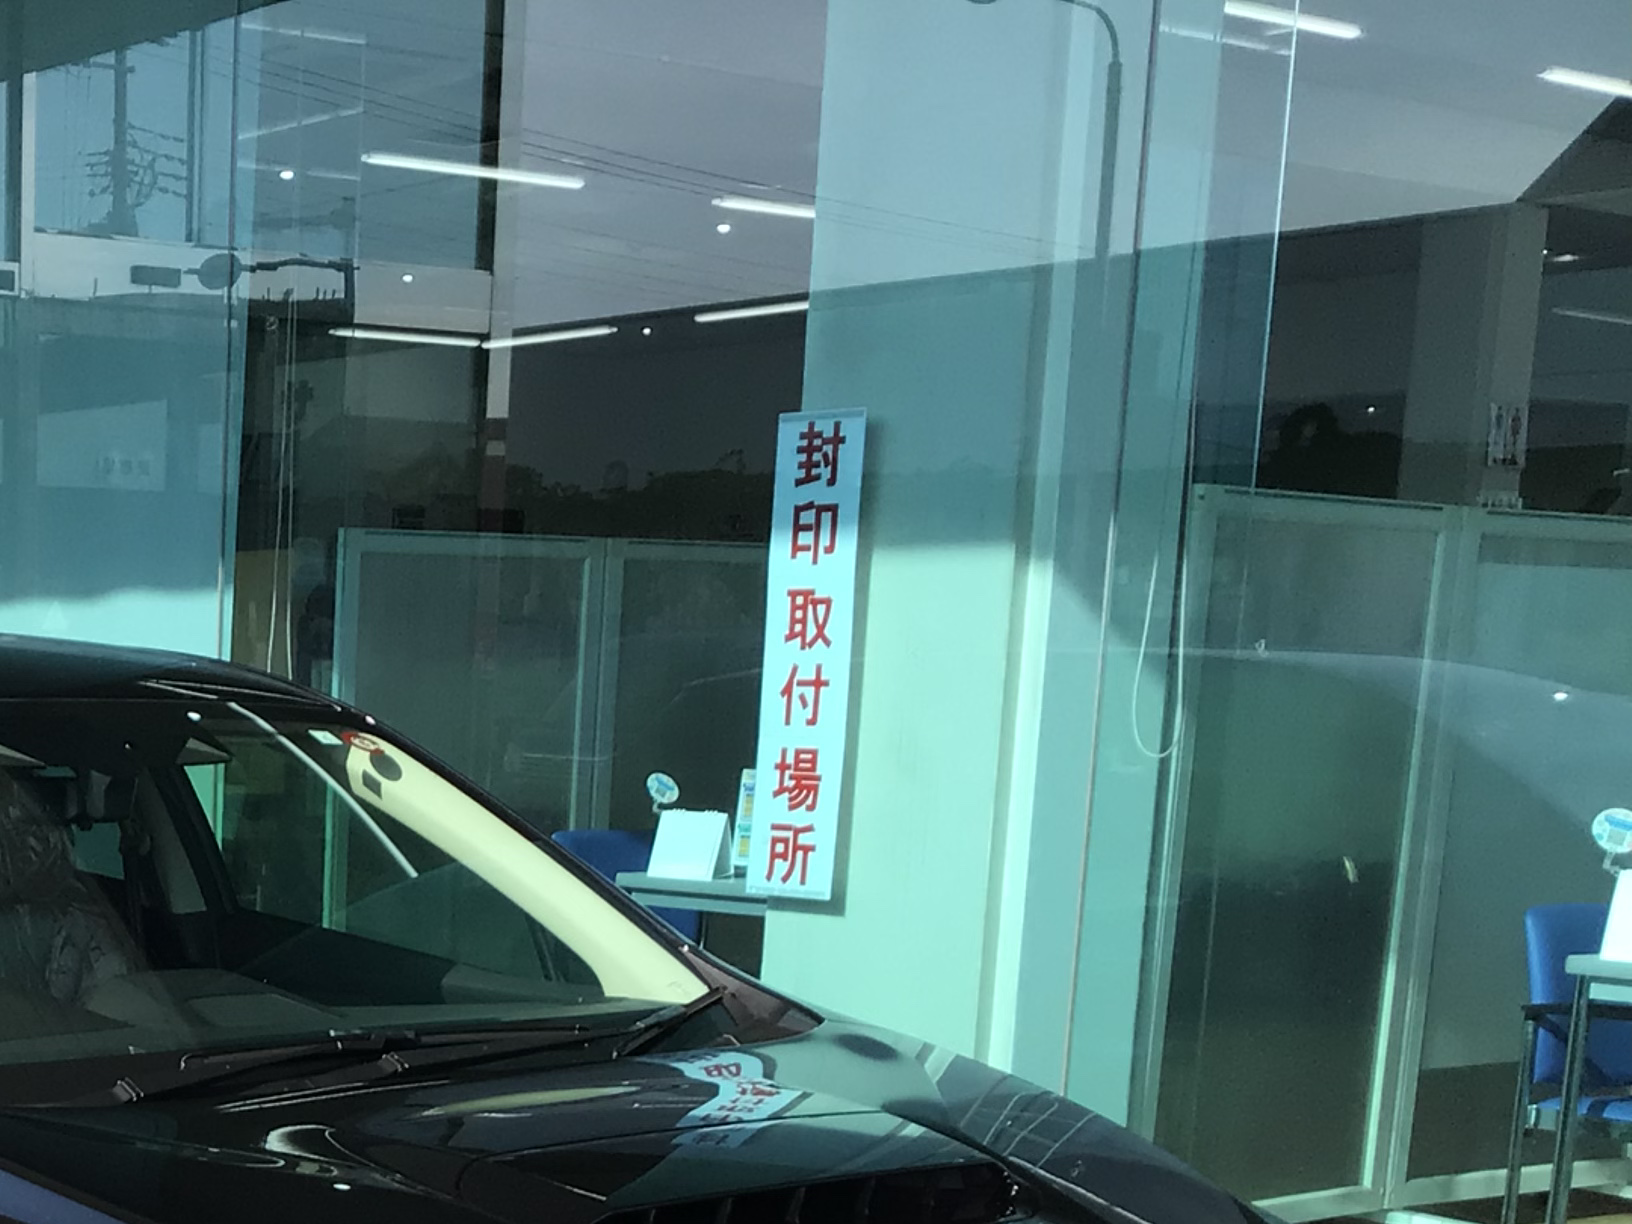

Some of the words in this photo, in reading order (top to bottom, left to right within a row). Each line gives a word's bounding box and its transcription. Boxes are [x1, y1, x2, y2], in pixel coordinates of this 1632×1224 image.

[765, 420, 847, 886] 封印取付場所
